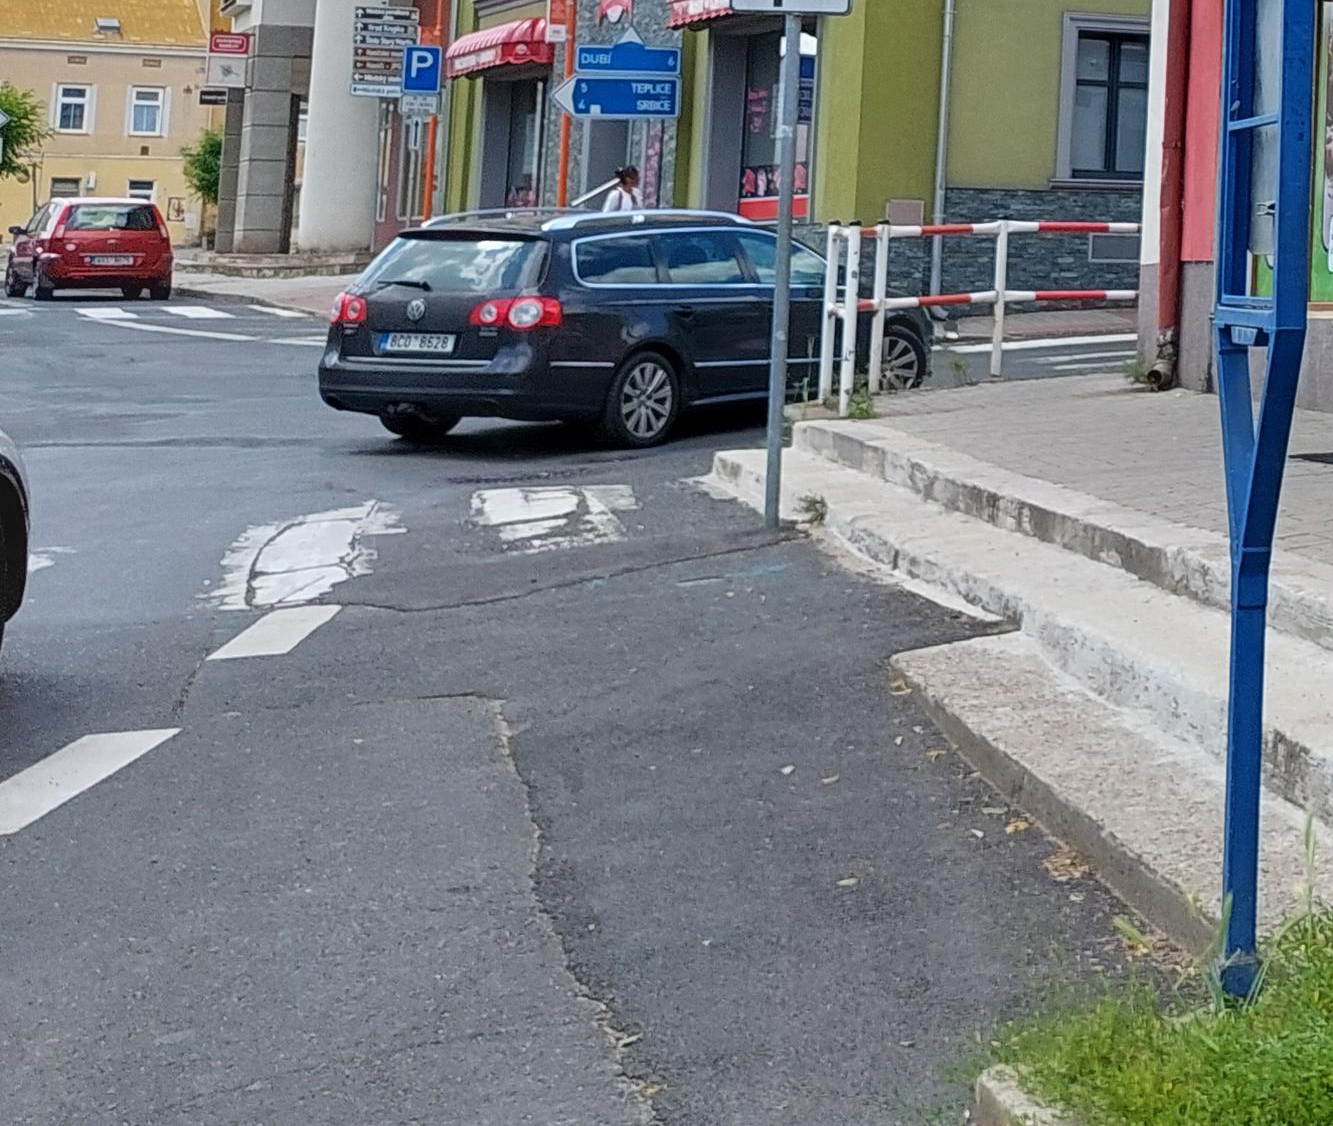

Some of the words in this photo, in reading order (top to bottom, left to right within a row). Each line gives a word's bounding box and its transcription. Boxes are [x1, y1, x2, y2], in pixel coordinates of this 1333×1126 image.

[411, 50, 434, 79] P
[580, 52, 613, 65] DUBÍ
[667, 56, 676, 67] 6
[580, 82, 589, 94] 5
[631, 82, 673, 95] TEPLICE
[636, 99, 672, 112] SRBICE
